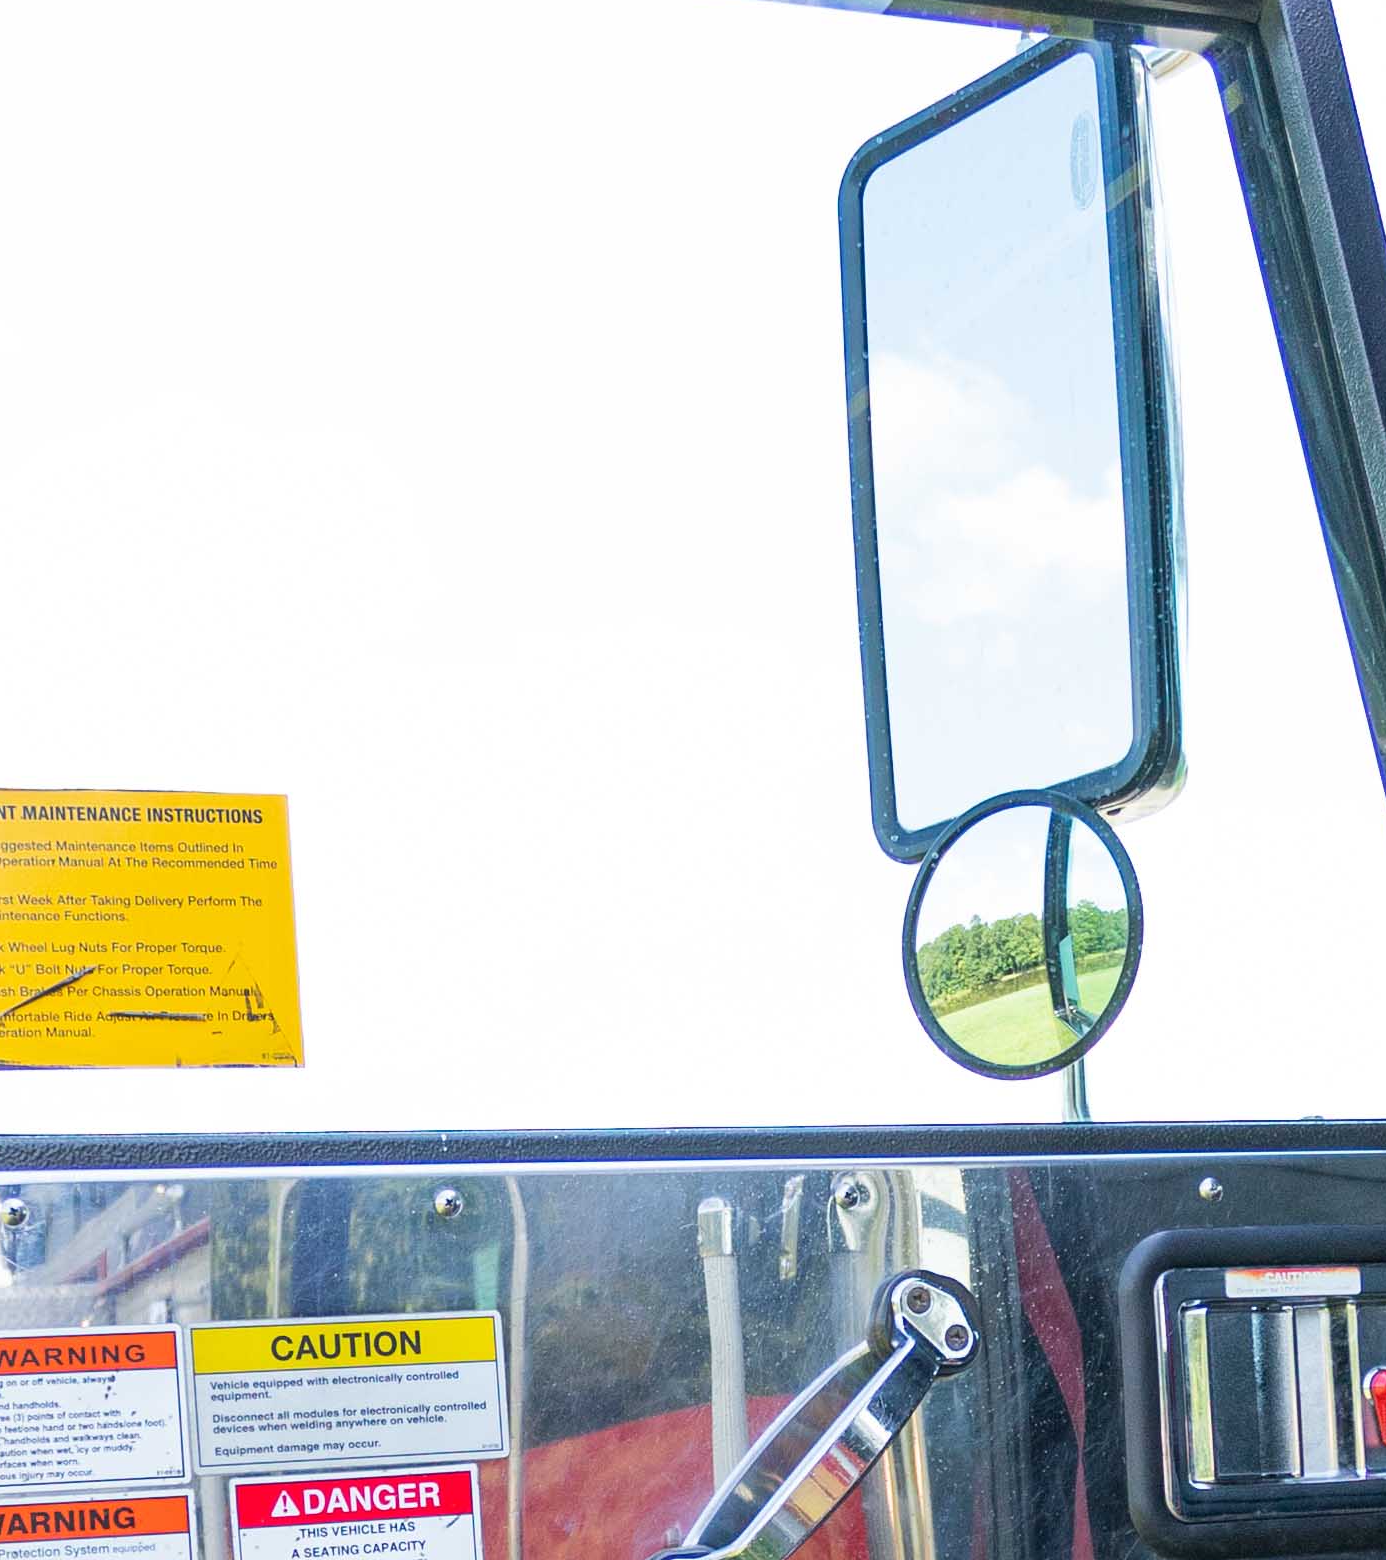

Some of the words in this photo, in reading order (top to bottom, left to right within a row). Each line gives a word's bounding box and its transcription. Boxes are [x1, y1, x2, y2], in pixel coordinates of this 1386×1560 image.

[20, 805, 141, 821] MAINTENANCE
[147, 808, 263, 823] INSTRUCTIONS
[56, 840, 137, 855] Maintenance
[139, 841, 174, 855] Items
[177, 842, 228, 853] Outlined
[232, 842, 243, 852] In
[58, 856, 104, 870] Manual
[104, 856, 121, 867] At
[125, 856, 148, 868] The
[151, 857, 244, 868] Recommended
[247, 858, 277, 869] Time
[15, 894, 53, 908] Week
[56, 895, 87, 905] After
[89, 894, 131, 908] Taking
[134, 895, 183, 908] Delivery
[187, 895, 236, 906] Perform
[239, 895, 262, 906] The
[64, 910, 129, 921] Functions.
[8, 942, 47, 953] Wheel
[51, 941, 75, 955] Lug
[78, 941, 108, 952] Nuts
[111, 941, 132, 952] For
[135, 942, 177, 954] Proper
[180, 942, 226, 954] Torque.
[271, 1330, 421, 1360] CAUTION
[31, 1377, 43, 1385] off
[45, 1376, 79, 1384] vehicle,
[210, 1380, 249, 1392] Vehicle
[252, 1378, 303, 1389] equipped
[306, 1376, 329, 1385] with
[331, 1373, 402, 1384] electronically
[405, 1370, 459, 1380] controlled
[210, 1391, 271, 1402] equipment.
[212, 1413, 274, 1424] Disconnect
[277, 1410, 289, 1419] all
[292, 1409, 339, 1422] modules
[342, 1407, 357, 1416] for
[360, 1404, 430, 1419] electronically
[433, 1401, 487, 1412] controlled
[213, 1425, 255, 1433] devices
[257, 1422, 287, 1431] when
[290, 1420, 332, 1430] welding
[335, 1418, 387, 1428] anywhere
[406, 1413, 446, 1423] vehicle.
[215, 1445, 273, 1456] Equipment
[276, 1443, 319, 1452] damage
[322, 1442, 344, 1451] may
[348, 1440, 381, 1448] occur.
[303, 1482, 440, 1513] DANGER
[300, 1527, 328, 1537] THIS
[331, 1523, 385, 1535] VEHICLE
[389, 1521, 415, 1532] HAS
[64, 1545, 109, 1557] System
[112, 1541, 155, 1553] equipped
[291, 1548, 300, 1558] A
[303, 1544, 359, 1557] SEATING
[363, 1540, 425, 1553] CAPACITY
